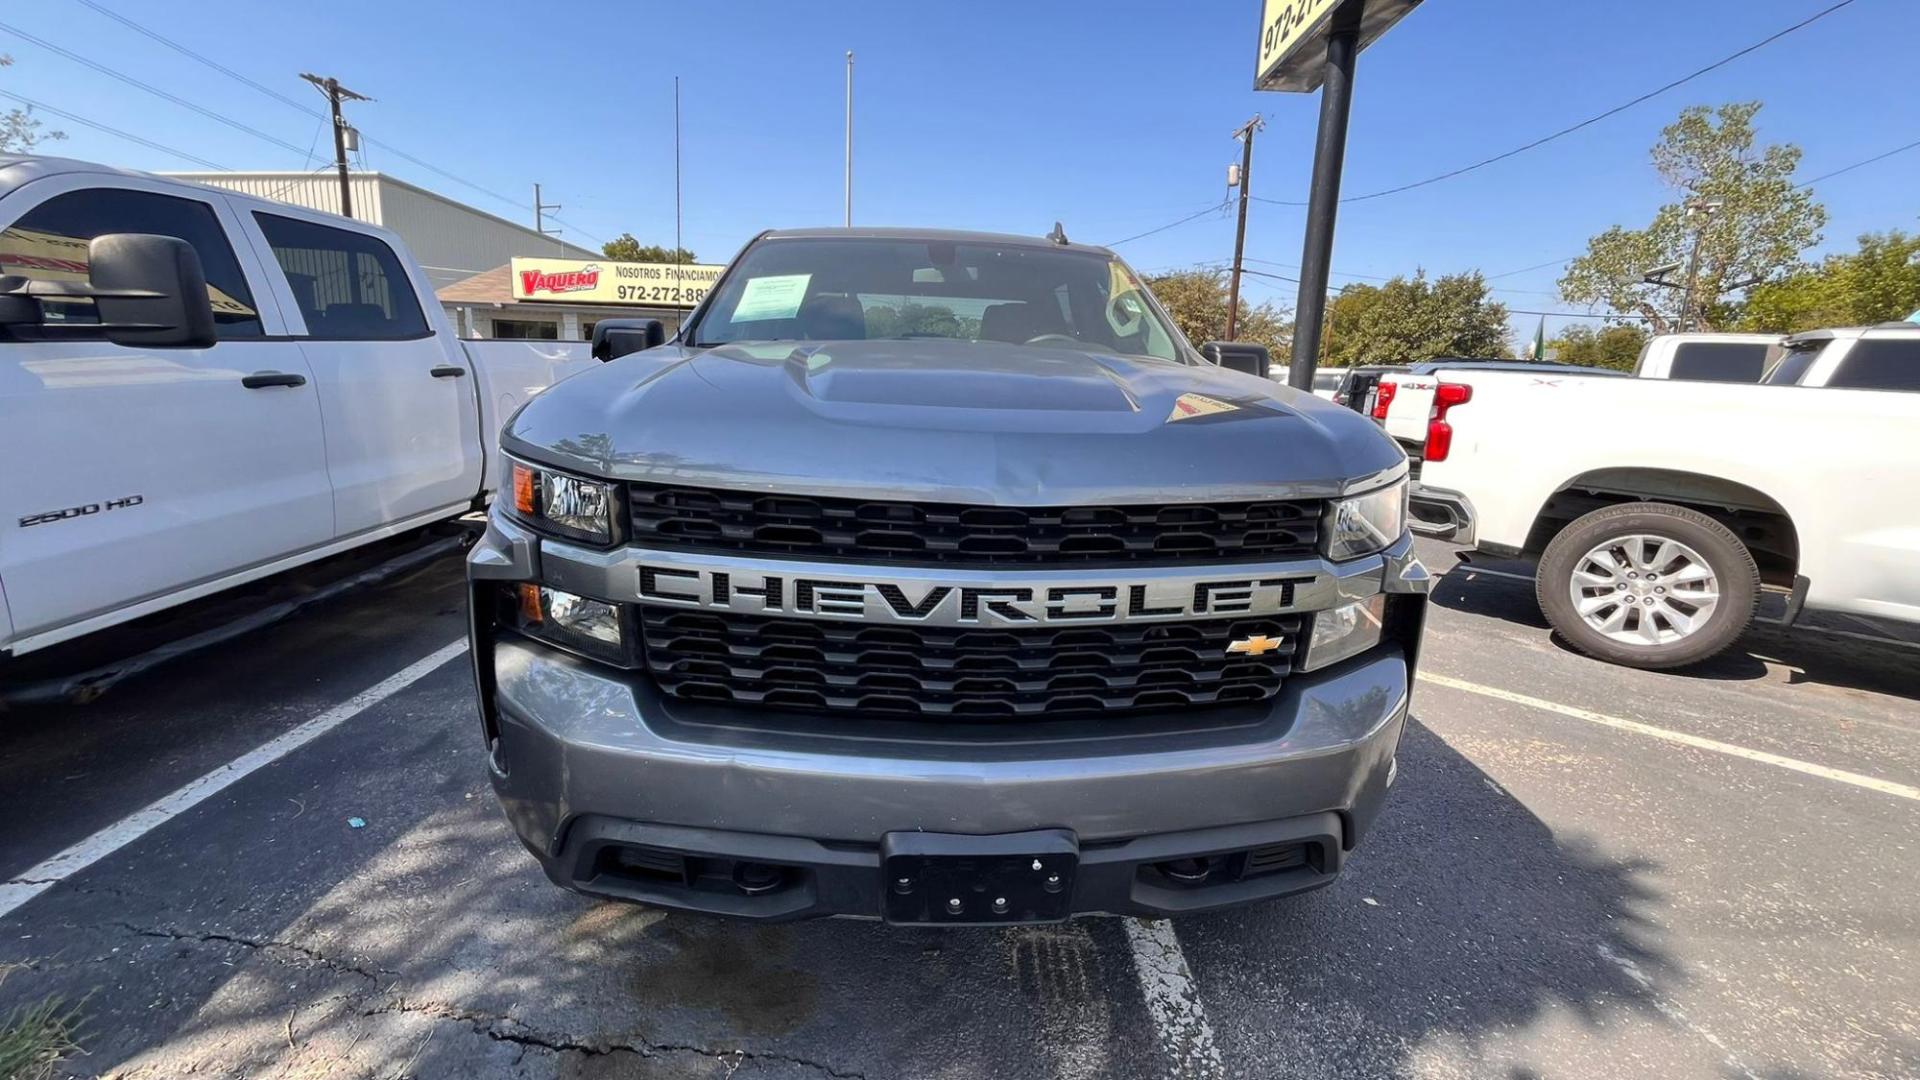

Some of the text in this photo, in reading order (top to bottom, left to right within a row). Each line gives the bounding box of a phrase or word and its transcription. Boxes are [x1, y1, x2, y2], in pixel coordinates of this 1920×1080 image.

[520, 269, 598, 295] VAQUERO
[616, 265, 722, 282] NOSOTROS FINANCIAMO
[617, 285, 709, 303] 972-272-88
[18, 494, 144, 527] 2500 HD
[637, 568, 1318, 623] CHEVROLET
